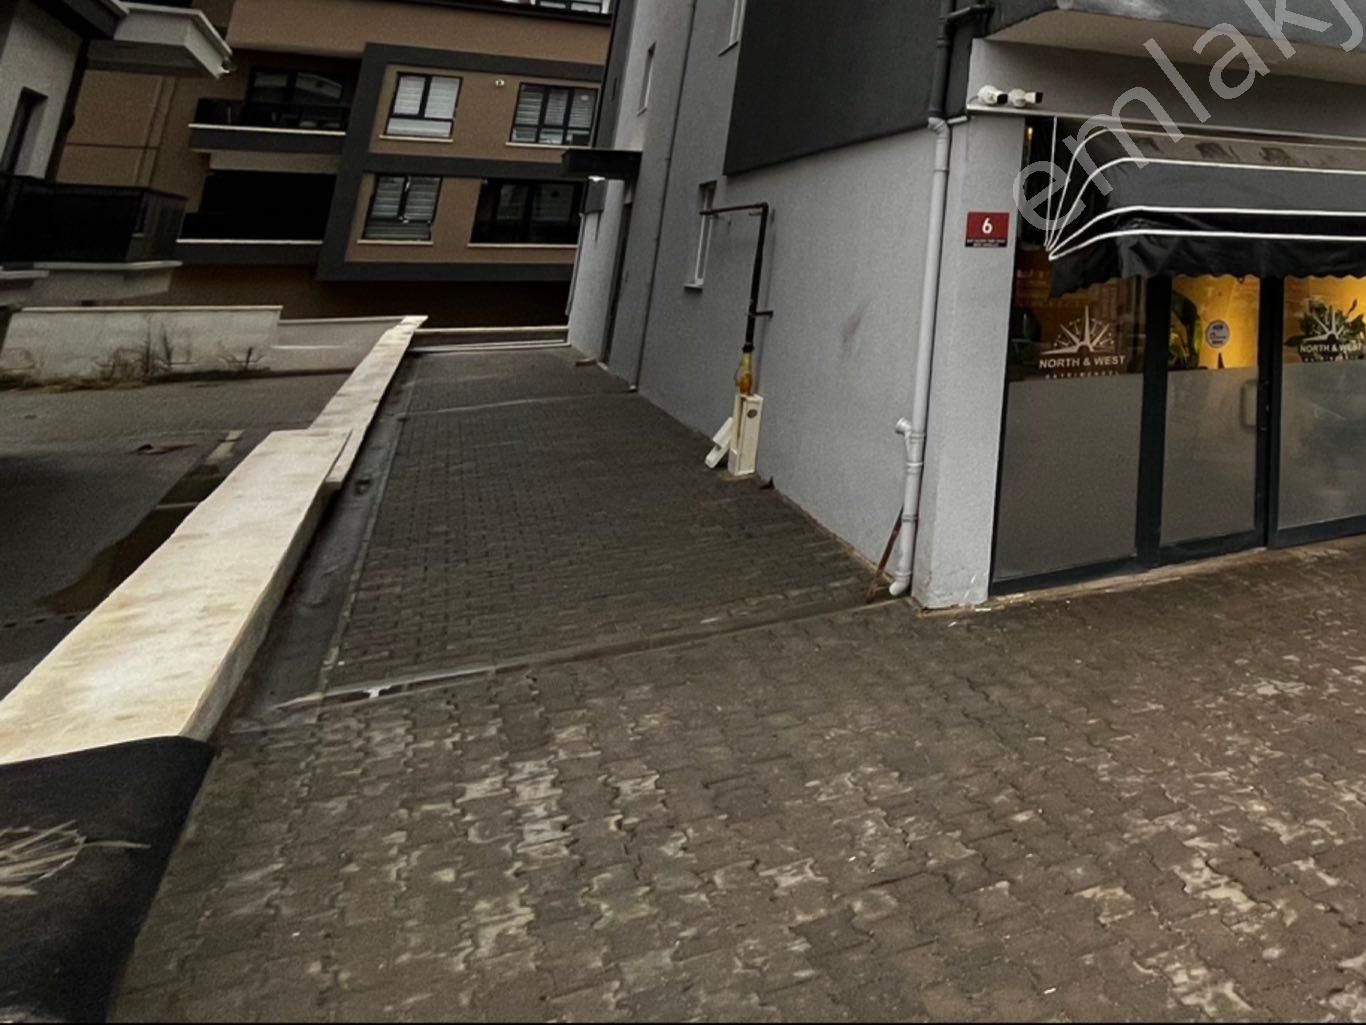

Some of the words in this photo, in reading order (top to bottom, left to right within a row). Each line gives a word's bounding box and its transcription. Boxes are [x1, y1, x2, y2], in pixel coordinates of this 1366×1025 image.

[982, 217, 993, 234] 6
[1039, 358, 1080, 368] NORTH
[1083, 357, 1091, 366] &
[1094, 355, 1126, 365] WEST
